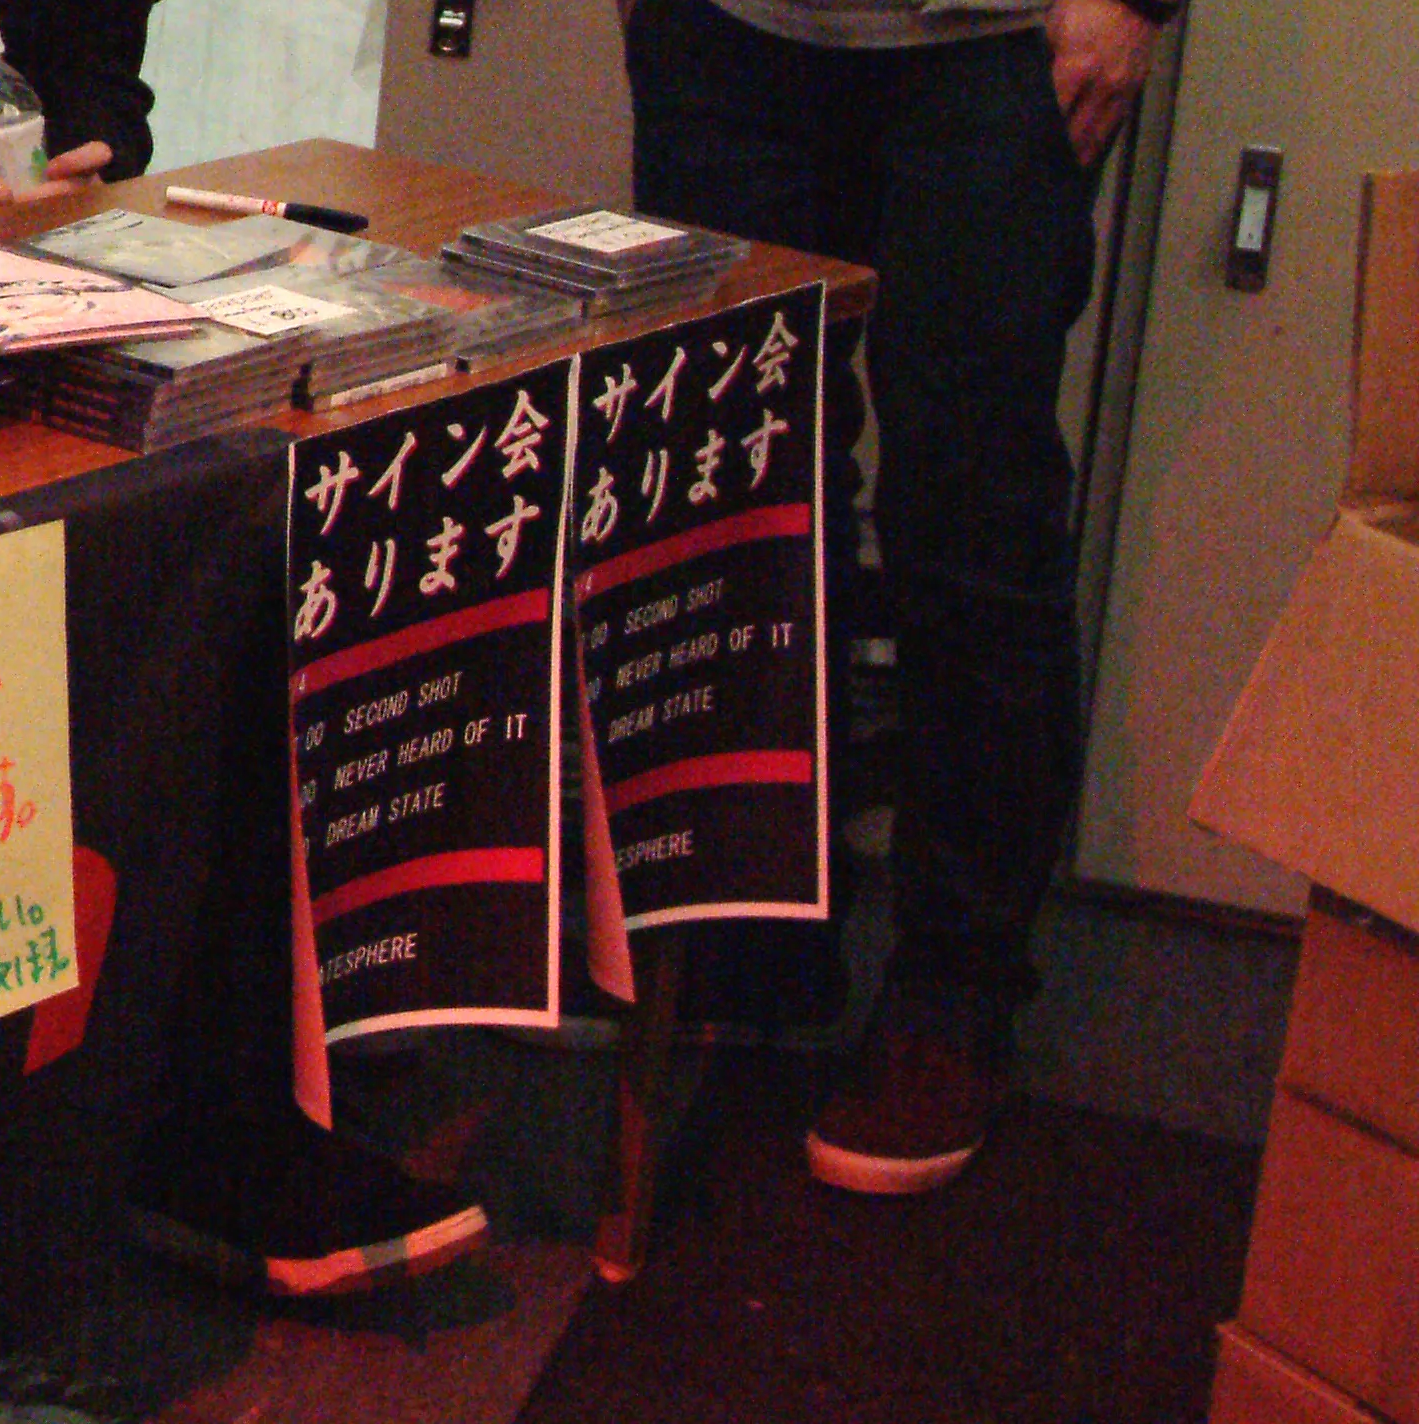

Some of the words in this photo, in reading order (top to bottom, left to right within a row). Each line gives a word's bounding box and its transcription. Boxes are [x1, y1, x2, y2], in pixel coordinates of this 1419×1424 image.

[593, 311, 798, 444] サイン会
[305, 391, 550, 535] サイン会
[580, 409, 791, 547] あります
[293, 495, 541, 643] あります
[344, 690, 409, 734] SECOND
[418, 671, 463, 708] SHOT
[616, 650, 662, 690] NEVER
[669, 631, 719, 668] HEARD
[729, 625, 755, 652] OF
[771, 622, 794, 648] IT
[334, 749, 389, 791] NEVER
[397, 727, 453, 766] HEARD
[464, 718, 491, 745] OF
[505, 714, 528, 739] IT
[326, 804, 380, 848] DREAM
[388, 782, 447, 824] STATE
